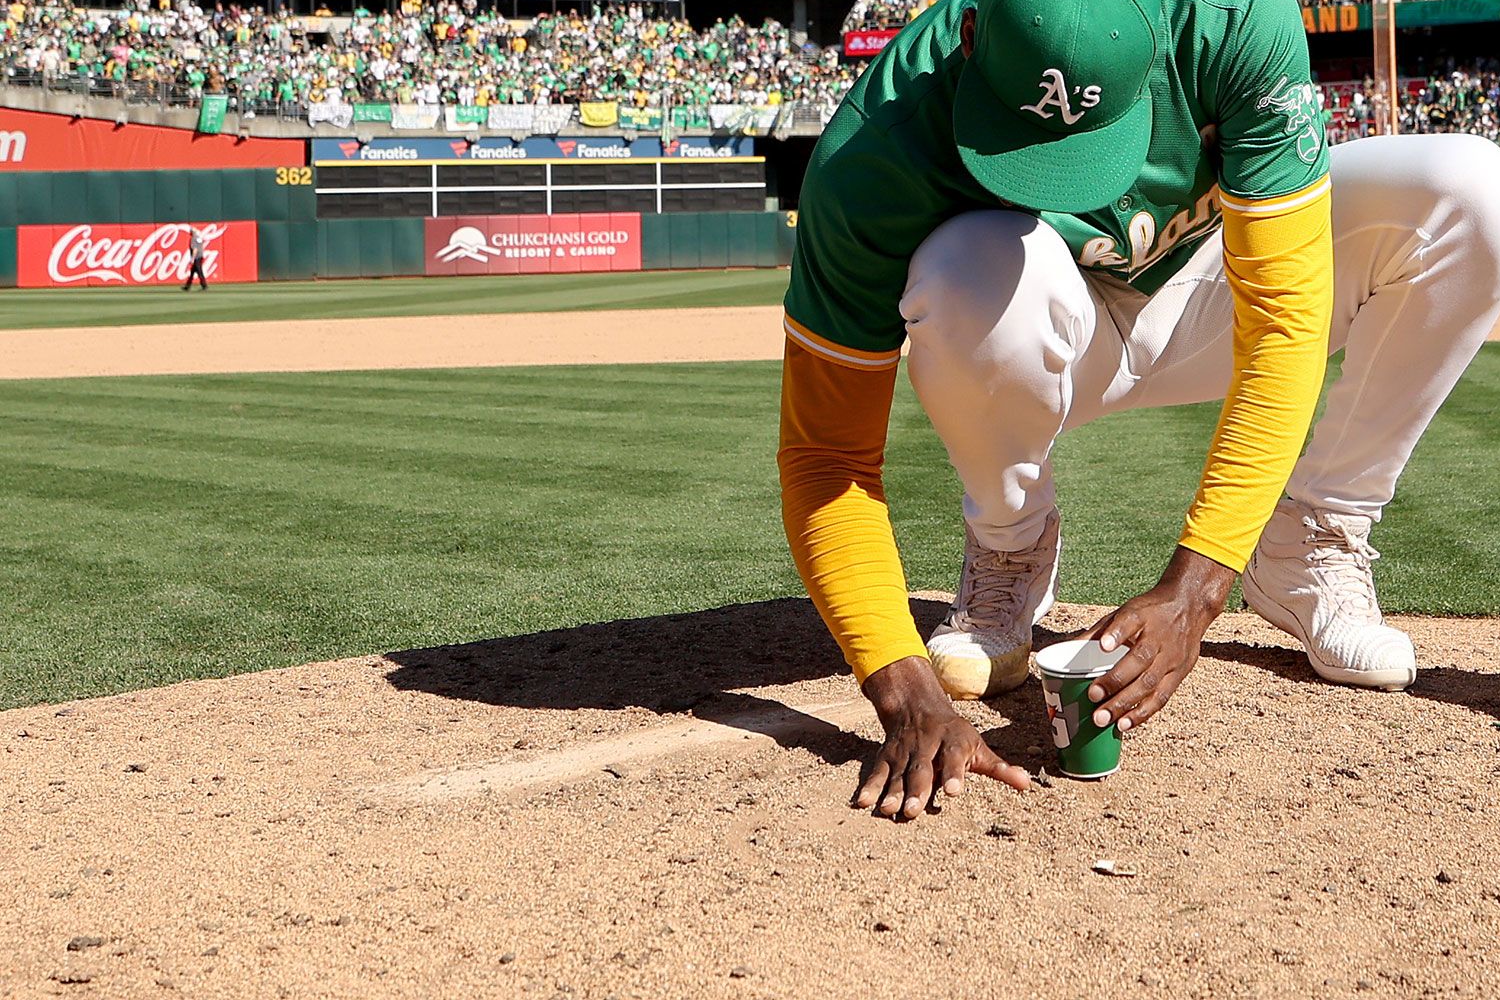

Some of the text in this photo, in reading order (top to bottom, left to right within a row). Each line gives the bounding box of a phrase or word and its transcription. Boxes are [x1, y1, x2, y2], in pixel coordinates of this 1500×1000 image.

[1020, 68, 1102, 125] A's
[360, 145, 418, 160] Fanatics
[471, 144, 527, 159] Fanatics
[577, 143, 631, 158] Fanatics
[275, 166, 313, 185] 362
[491, 229, 628, 248] CHUKCHANSI GOLD
[48, 223, 228, 284] Coca-Cola
[504, 244, 616, 259] RESORT & CASINO
